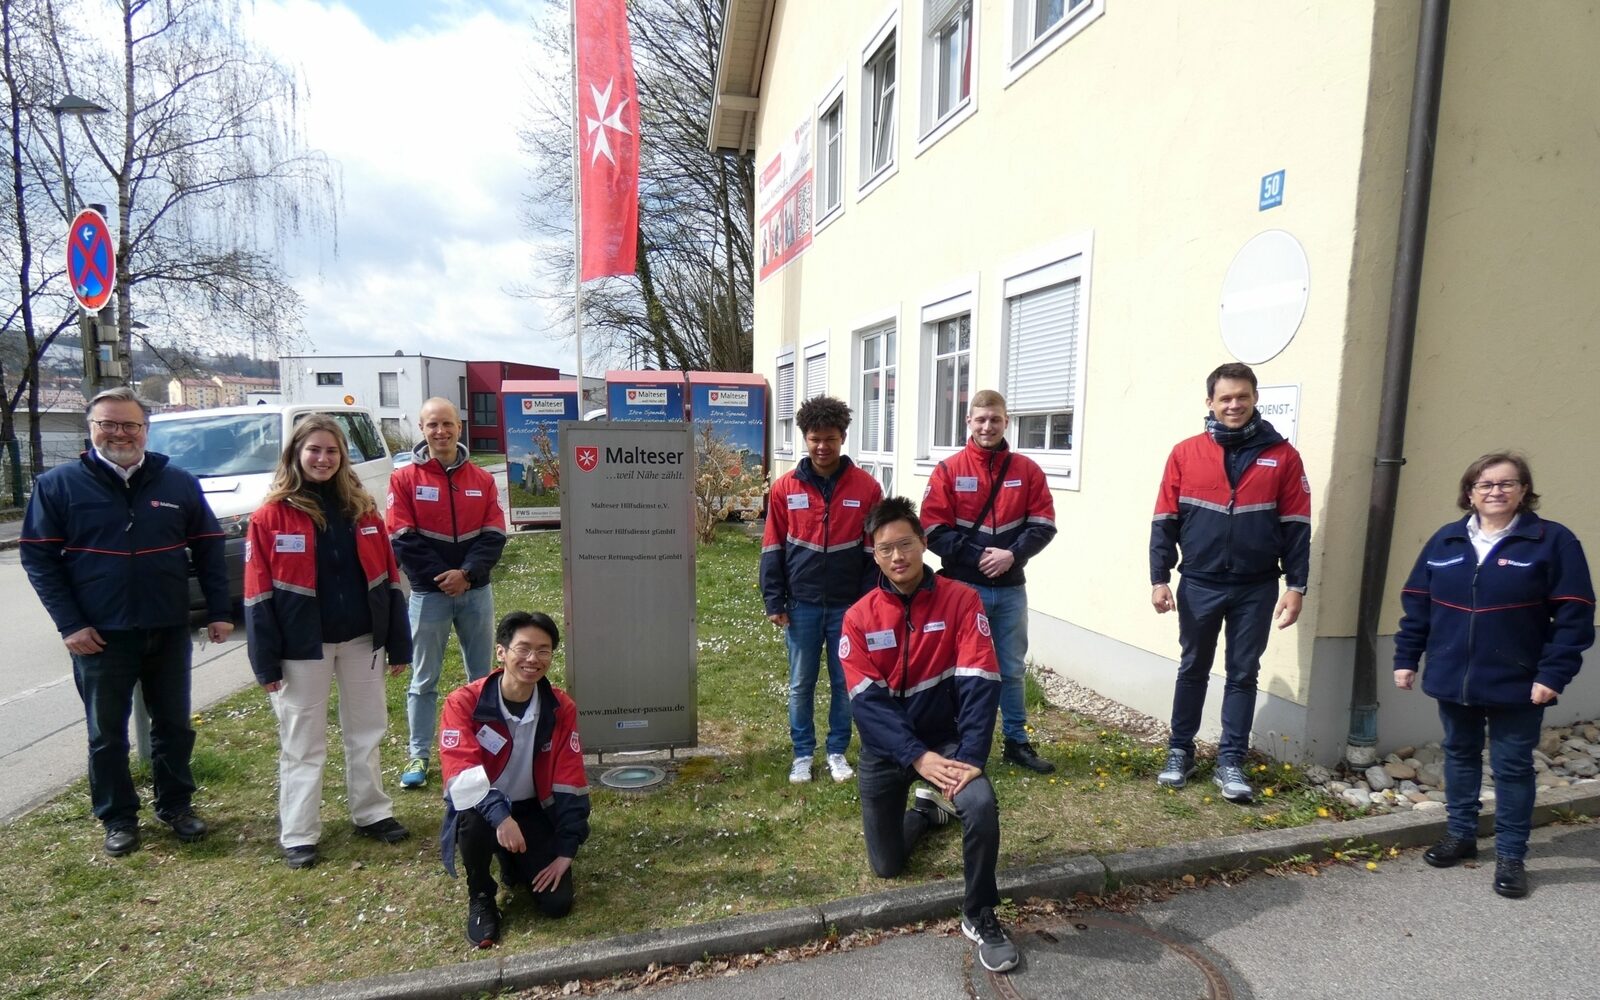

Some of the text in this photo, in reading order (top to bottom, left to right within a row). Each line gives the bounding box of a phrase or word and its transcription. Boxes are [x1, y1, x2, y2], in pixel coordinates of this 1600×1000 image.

[1264, 174, 1280, 198] 50
[1256, 403, 1293, 415] DIENST-
[605, 446, 684, 464] Malteser
[636, 470, 659, 480] Nähe
[661, 470, 685, 480] zählt.
[651, 528, 676, 536] gGmbH
[579, 704, 685, 716] www.malteser-passau.de
